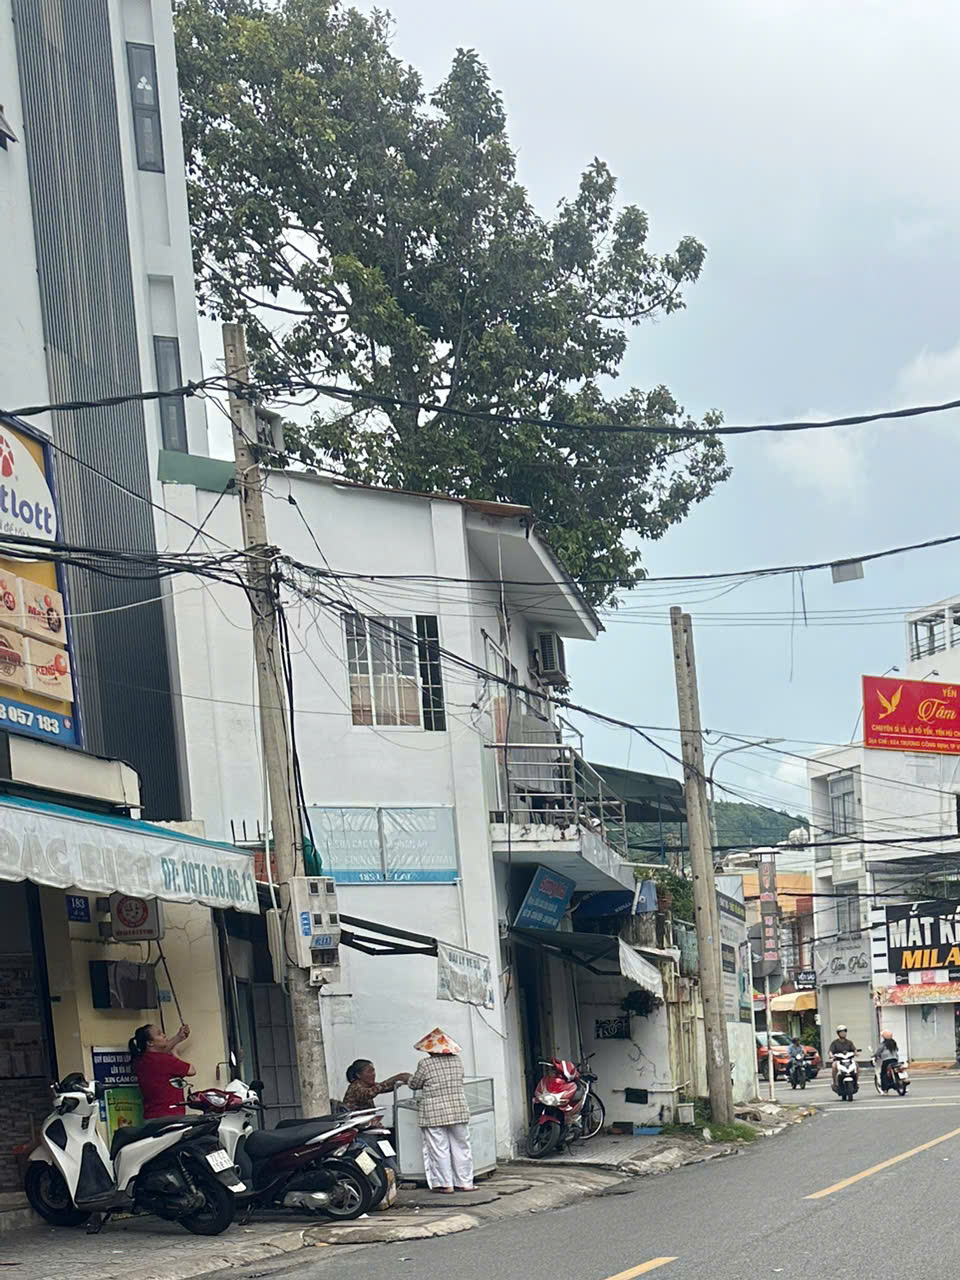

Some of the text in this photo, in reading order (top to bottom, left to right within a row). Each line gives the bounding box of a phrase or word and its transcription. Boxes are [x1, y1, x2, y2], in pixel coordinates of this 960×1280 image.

[942, 686, 958, 698] YẾN
[8, 706, 34, 727] 057
[36, 713, 60, 735] 183
[917, 698, 957, 725] Tâm
[888, 903, 934, 949] MẮT
